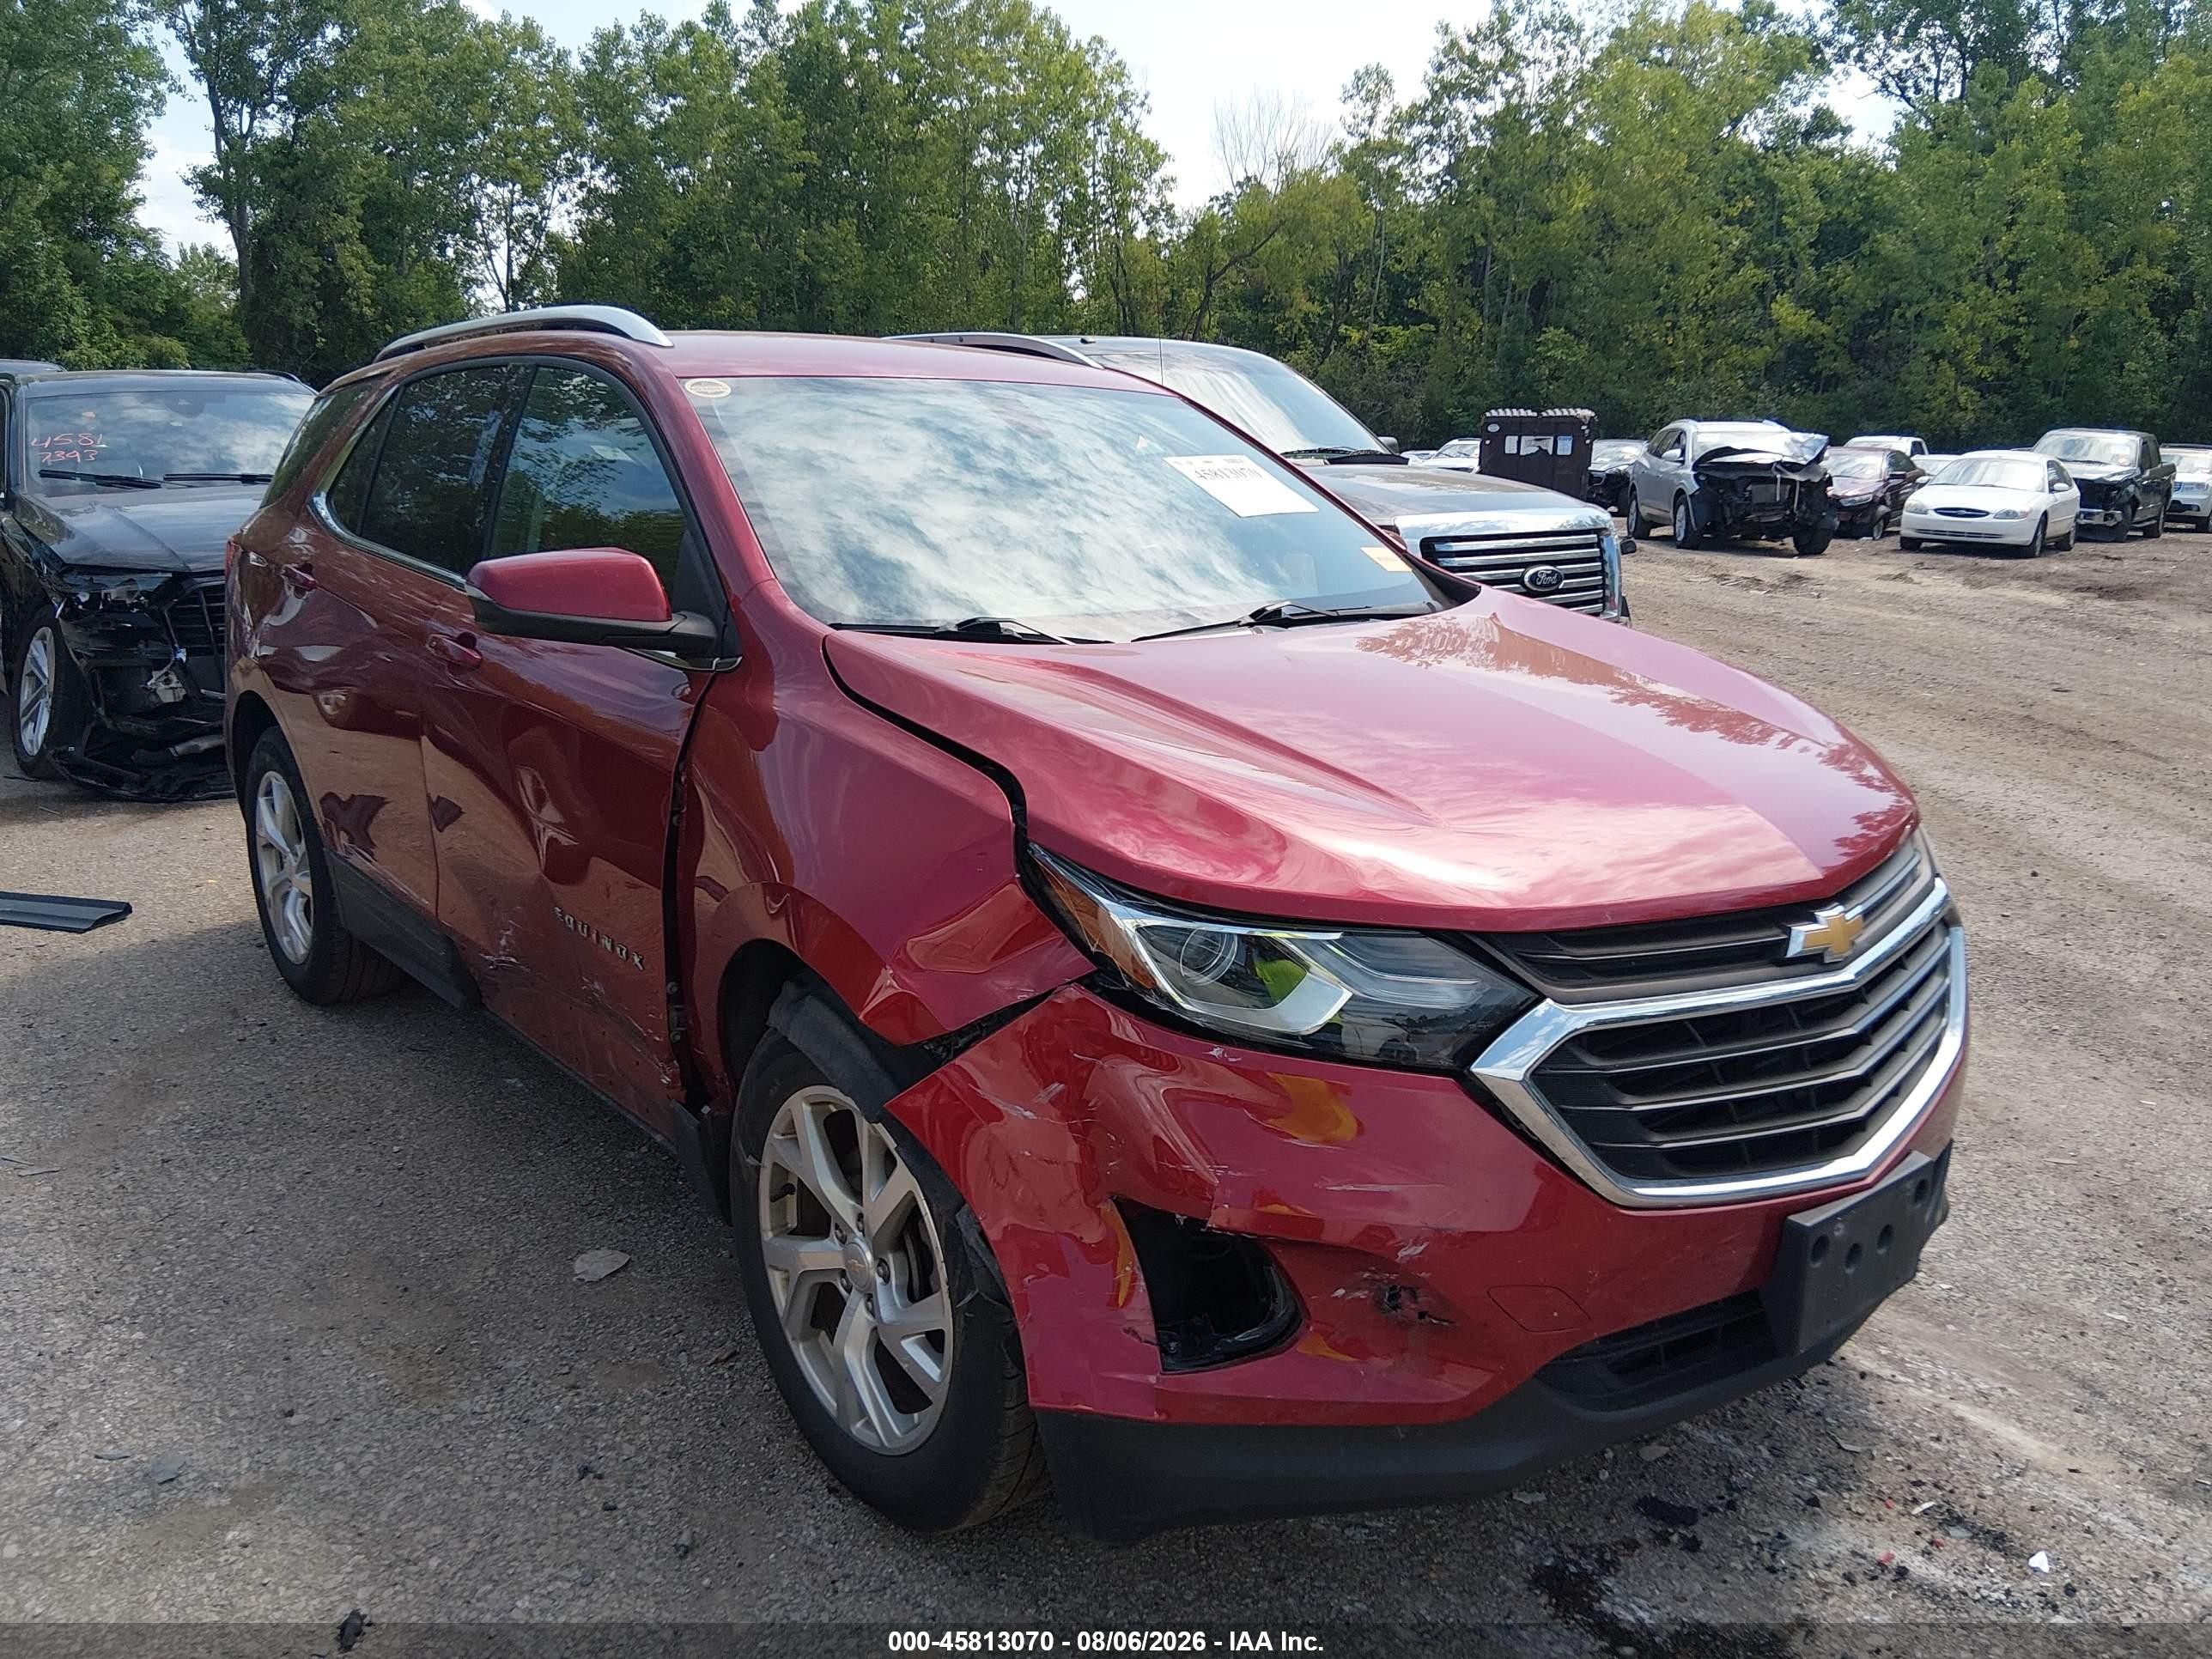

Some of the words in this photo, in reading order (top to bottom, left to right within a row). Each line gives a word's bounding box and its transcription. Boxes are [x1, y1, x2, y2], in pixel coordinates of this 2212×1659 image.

[31, 433, 102, 447] 4581
[37, 449, 99, 465] 7393
[1535, 569, 1558, 586] Ford
[553, 906, 645, 971] EQUINOX
